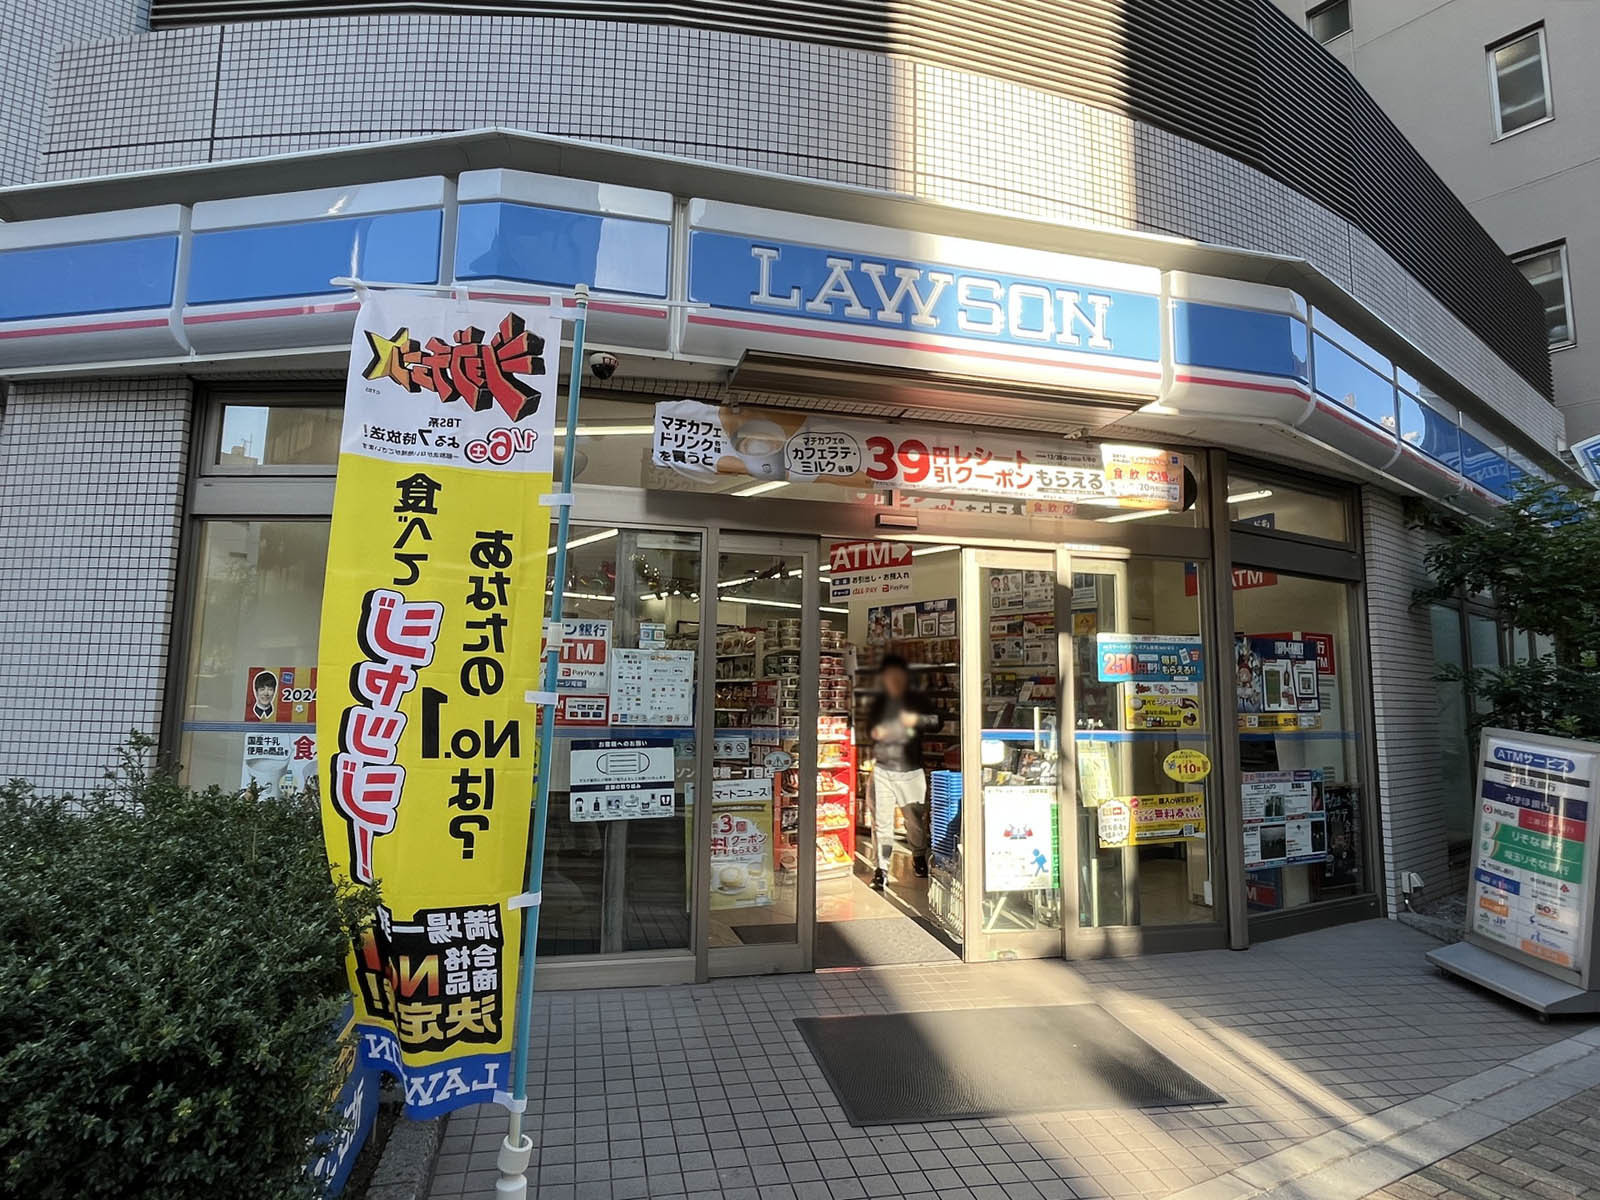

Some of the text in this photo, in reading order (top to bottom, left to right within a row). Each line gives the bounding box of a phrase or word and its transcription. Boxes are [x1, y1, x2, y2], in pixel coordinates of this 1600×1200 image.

[750, 246, 1114, 351] LAWSON
[660, 415, 723, 439] マチカフェ
[802, 436, 845, 446] マチカフェの
[658, 450, 714, 466] を買うと
[865, 436, 931, 483] 39
[932, 445, 1031, 470] 円レシート
[934, 465, 1034, 490] 引クーポン
[1035, 469, 1104, 490] もらえる
[831, 541, 890, 571] ATM
[247, 736, 281, 746] 国産牛乳
[293, 735, 317, 760] 食
[1496, 748, 1570, 772] ATMサービス
[712, 787, 768, 799] マートニュース
[731, 832, 767, 846] クーポン
